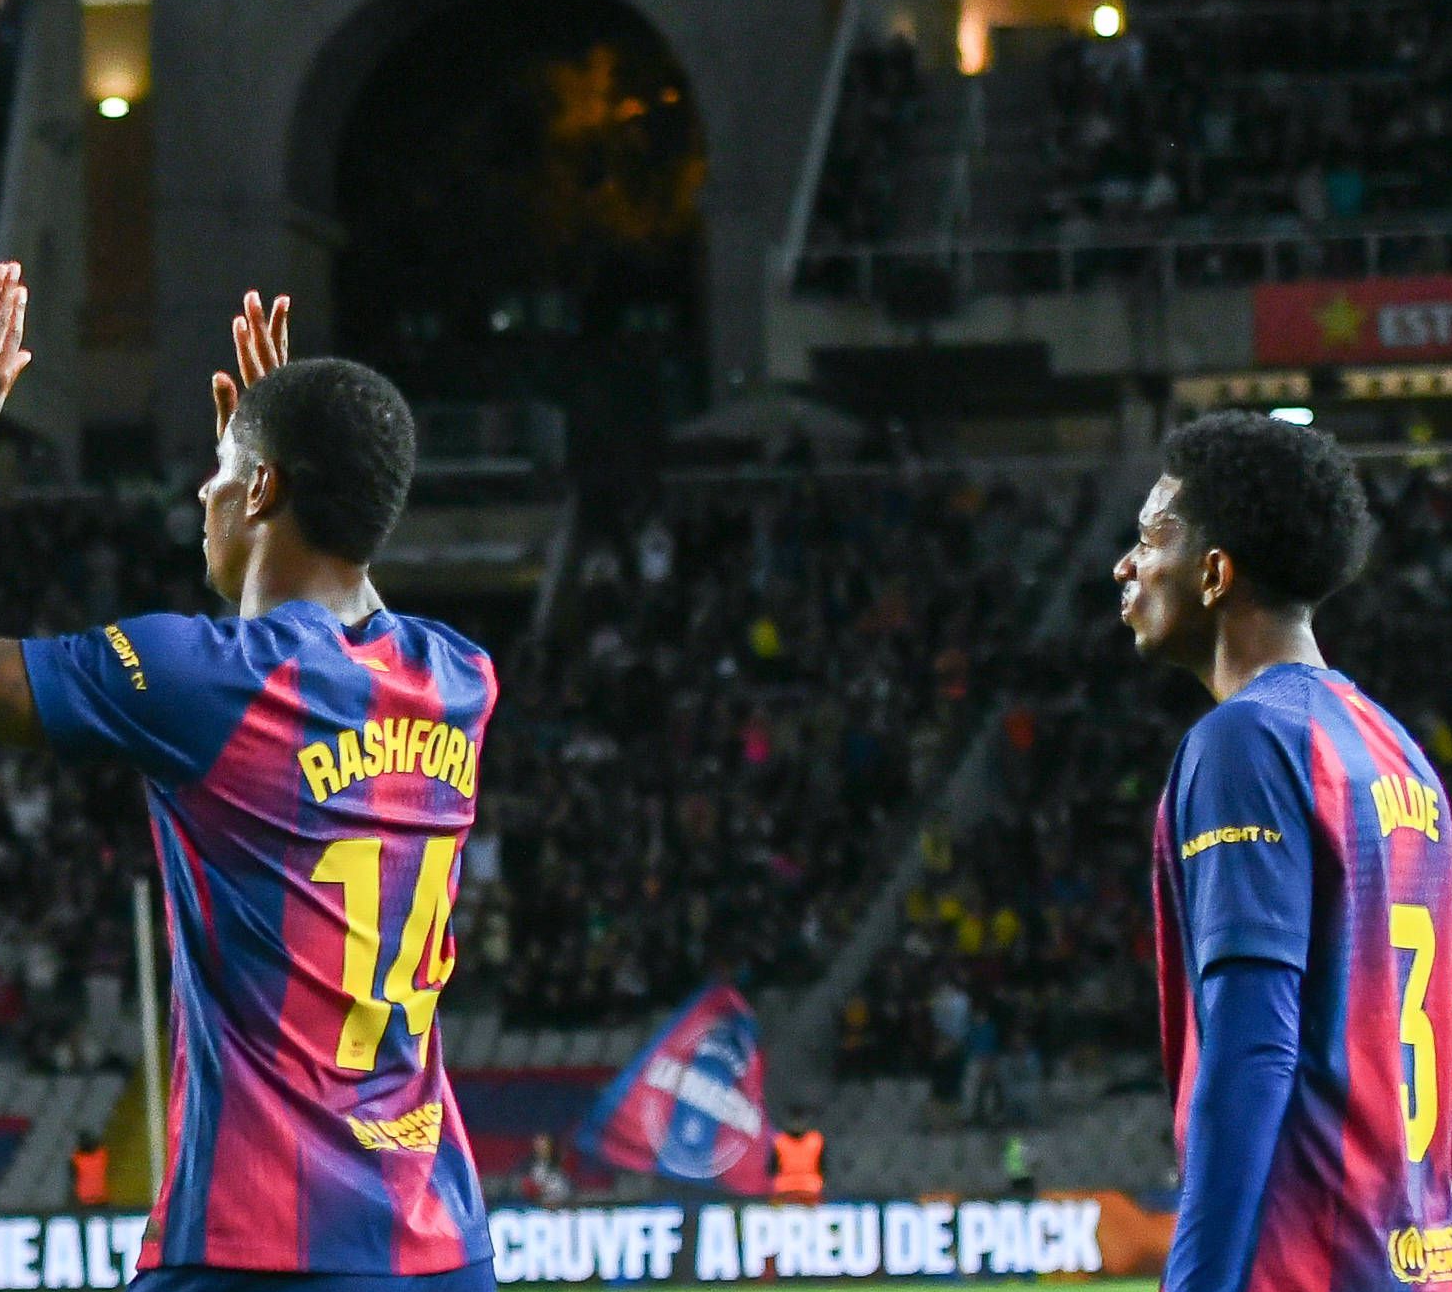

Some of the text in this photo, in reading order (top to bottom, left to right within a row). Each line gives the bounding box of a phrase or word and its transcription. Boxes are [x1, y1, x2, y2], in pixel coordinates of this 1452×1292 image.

[297, 716, 477, 804] RASHFORD
[1370, 773, 1440, 845] BALDE
[311, 836, 459, 1072] 14
[1389, 904, 1440, 1163] 3
[43, 1216, 84, 1289] A
[489, 1199, 1102, 1283] CRUYFF A PREU DE PACK
